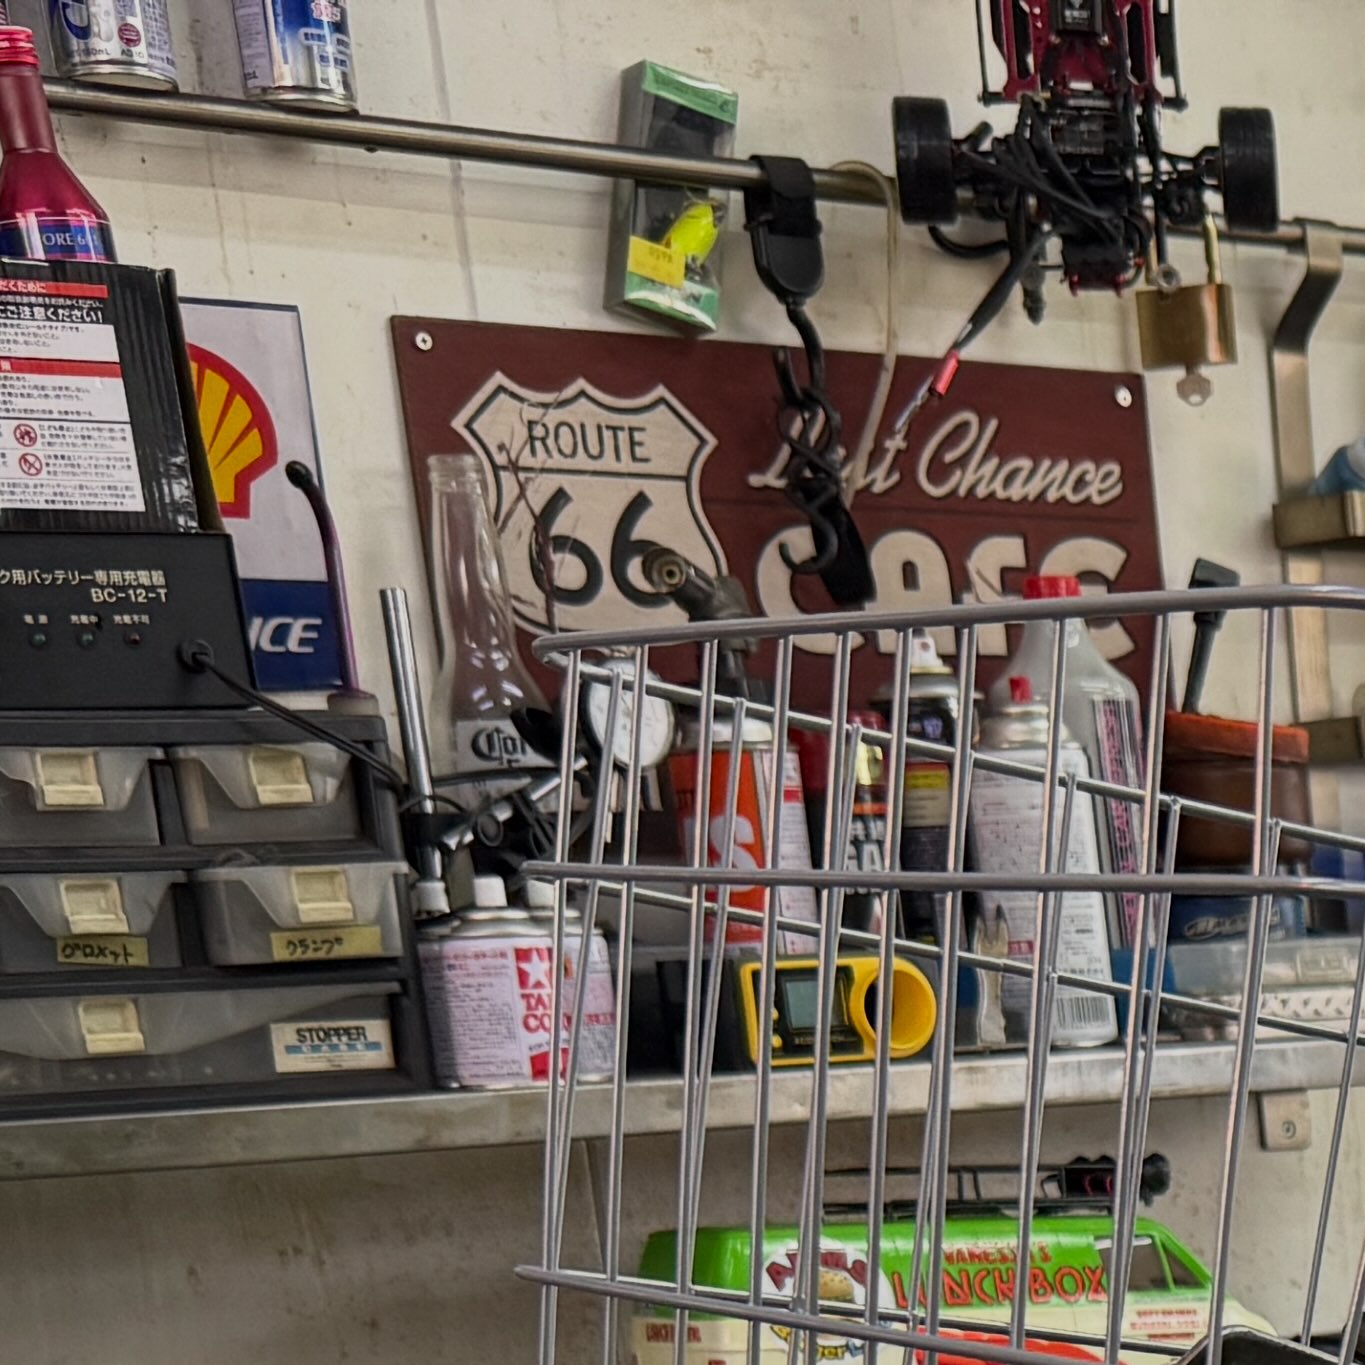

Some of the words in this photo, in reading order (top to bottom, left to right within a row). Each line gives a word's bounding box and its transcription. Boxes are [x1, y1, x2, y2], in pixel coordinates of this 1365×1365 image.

[526, 419, 652, 464] ROUTE
[916, 411, 1124, 505] Chance
[528, 486, 672, 609] 66
[91, 588, 168, 603] BC-12-T
[296, 1025, 368, 1044] STOPPER
